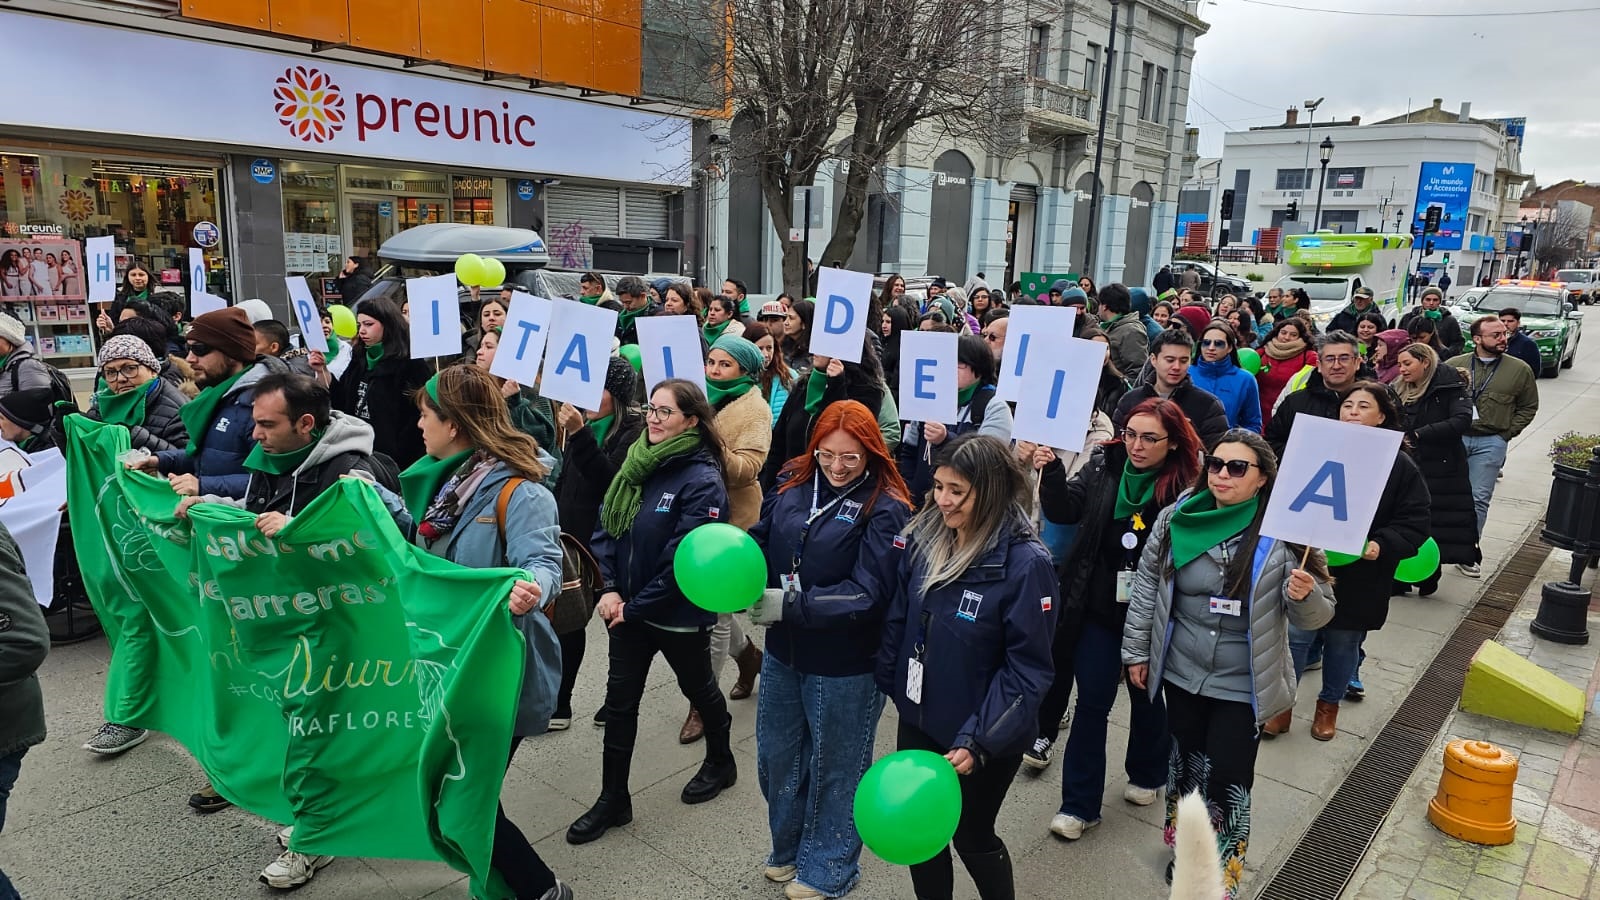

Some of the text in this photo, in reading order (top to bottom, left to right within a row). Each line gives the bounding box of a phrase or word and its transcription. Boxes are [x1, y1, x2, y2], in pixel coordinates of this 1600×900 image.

[356, 92, 536, 148] preunic
[1430, 177, 1464, 186] Un mundo
[20, 223, 63, 233] preunic
[96, 253, 110, 282] H
[297, 299, 313, 335] P
[431, 300, 440, 336] I
[823, 294, 855, 335] D
[515, 320, 541, 361] T
[554, 332, 591, 383] A
[913, 358, 938, 400] E
[1046, 369, 1066, 419] I
[1287, 460, 1348, 522] A
